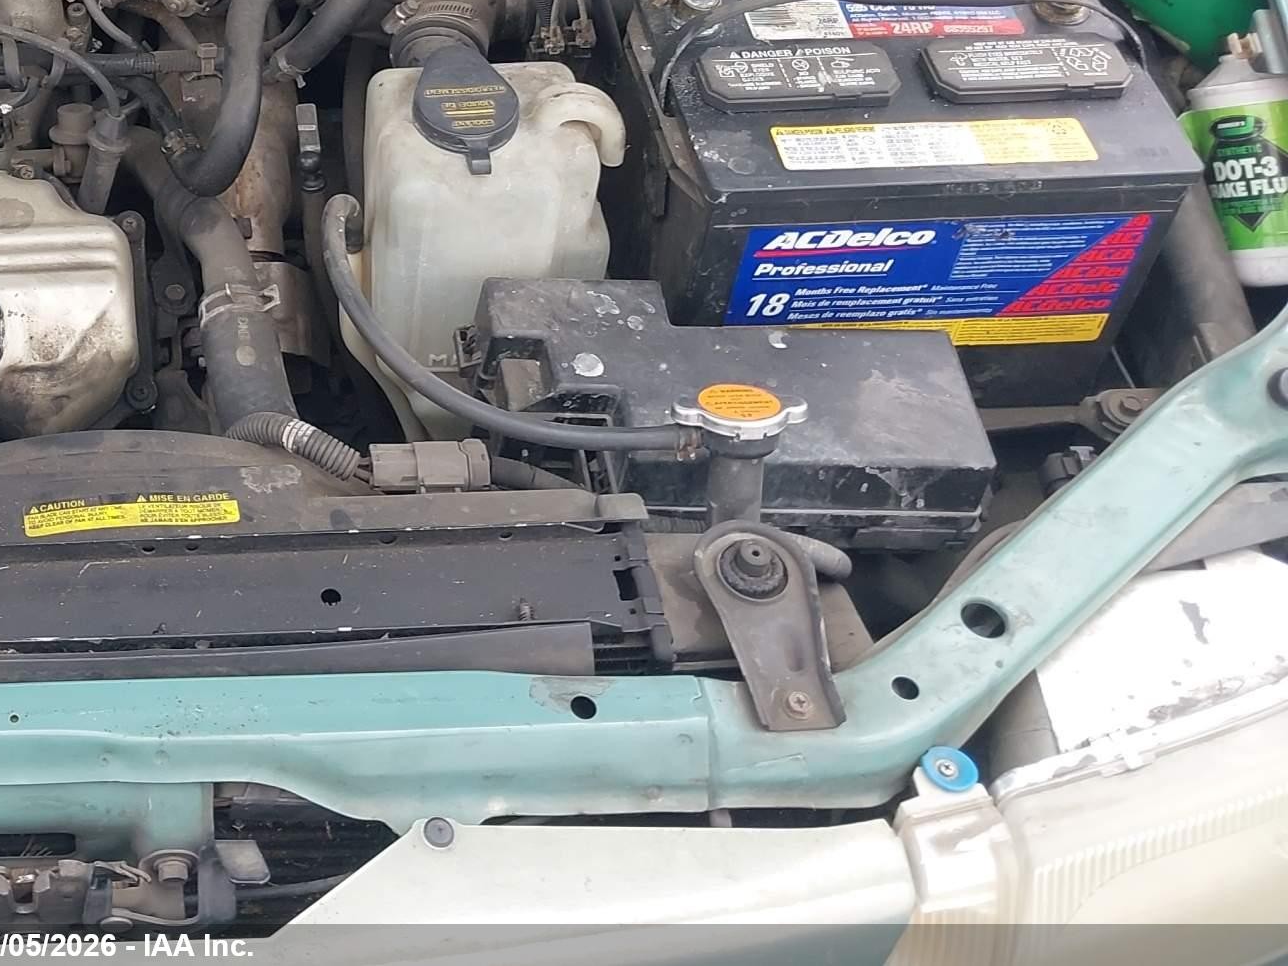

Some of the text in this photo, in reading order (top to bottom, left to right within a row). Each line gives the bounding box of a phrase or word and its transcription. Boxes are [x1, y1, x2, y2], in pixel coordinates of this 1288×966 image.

[890, 22, 934, 35] 24RP
[741, 46, 851, 59] DANGER POISON
[1212, 156, 1279, 182] DOT-3
[1250, 176, 1288, 196] FLU
[763, 227, 937, 250] ACDelco
[754, 259, 895, 277] Professional
[795, 287, 832, 296] Months
[833, 286, 855, 295] Free
[746, 293, 791, 317] 18
[791, 300, 816, 308] Mois
[817, 299, 831, 307] de
[831, 297, 902, 308] remplacement
[1001, 298, 1112, 311] ACDelco
[787, 312, 820, 320] Meses
[821, 310, 834, 318] de
[834, 309, 886, 320] reemplazo
[149, 492, 230, 502] MISE EN GARDE
[39, 499, 85, 512] CAUTION
